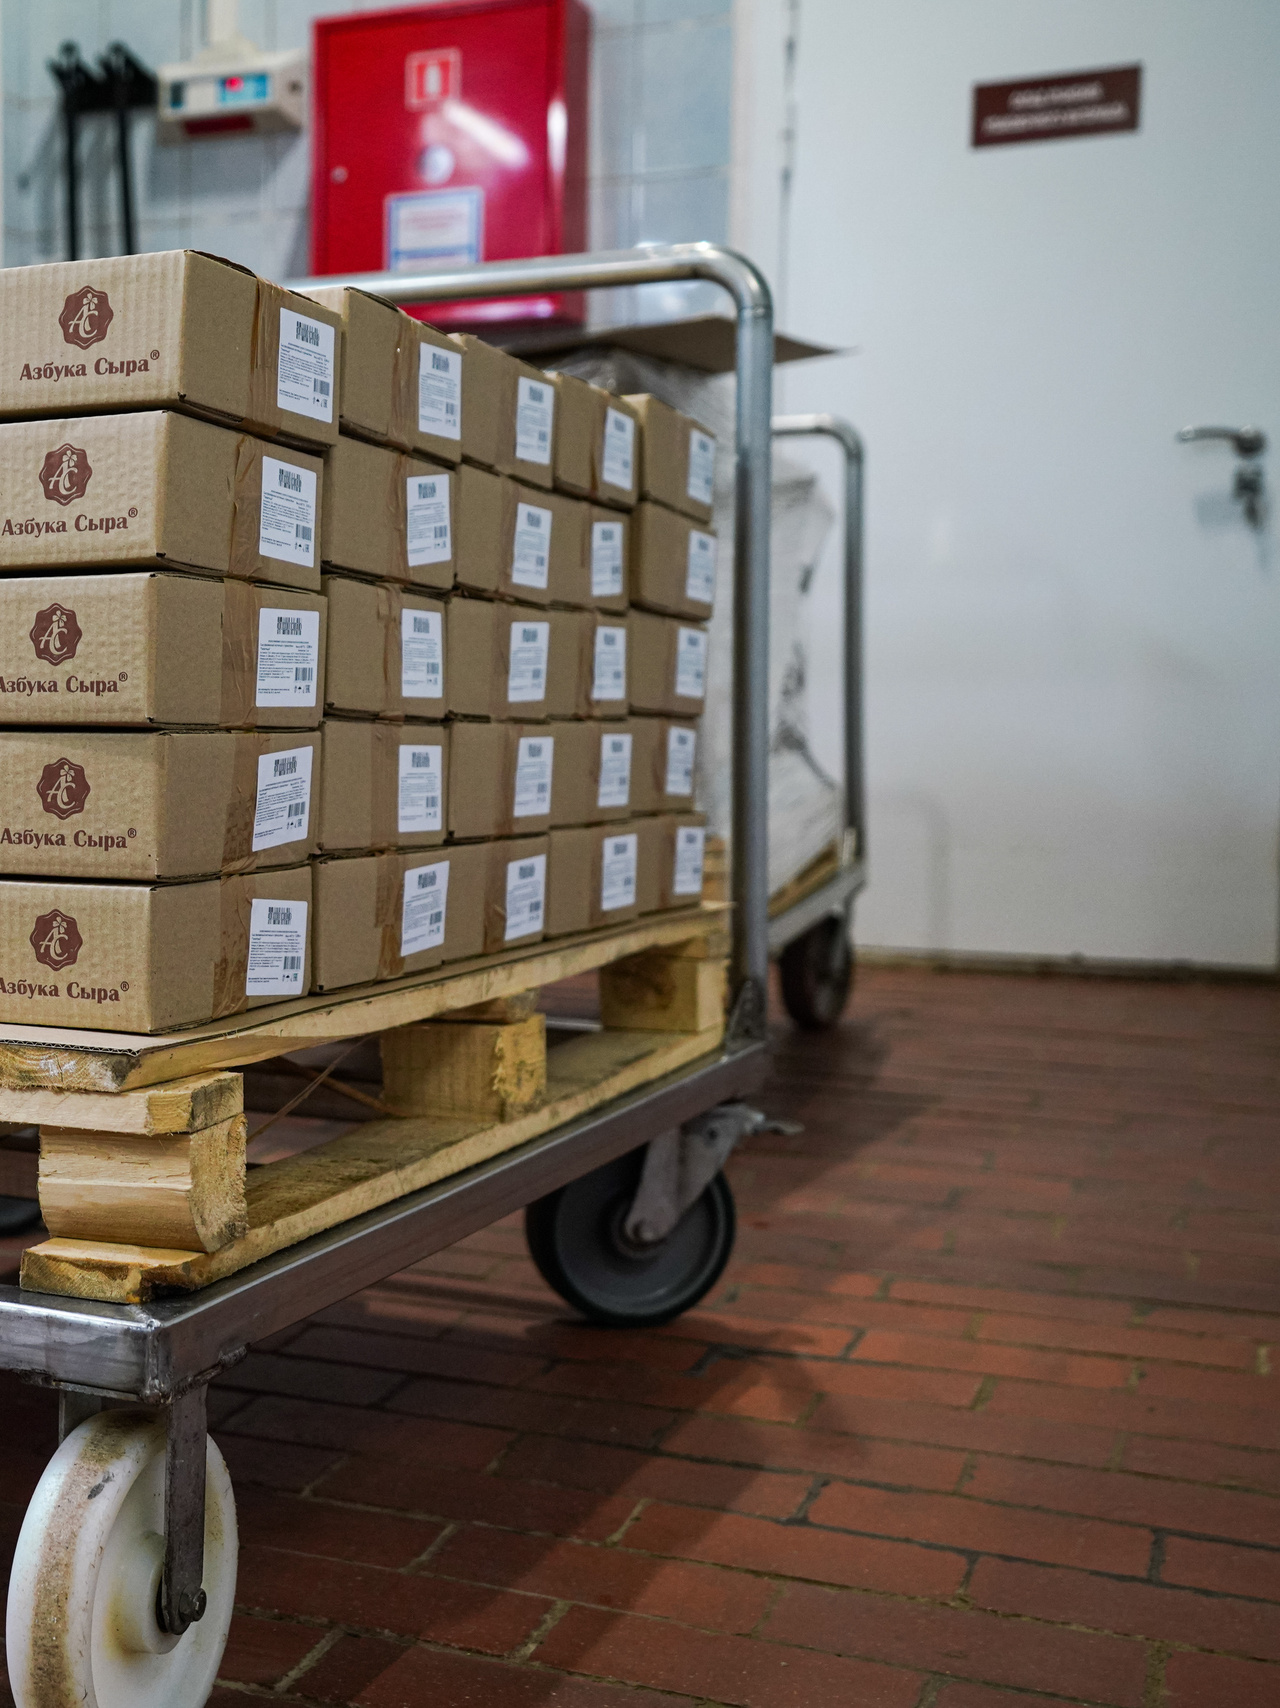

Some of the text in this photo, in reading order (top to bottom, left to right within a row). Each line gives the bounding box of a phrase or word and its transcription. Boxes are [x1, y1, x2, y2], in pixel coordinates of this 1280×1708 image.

[19, 363, 87, 382] Азбука
[2, 519, 67, 537] Азбука
[0, 828, 66, 848] Азбука
